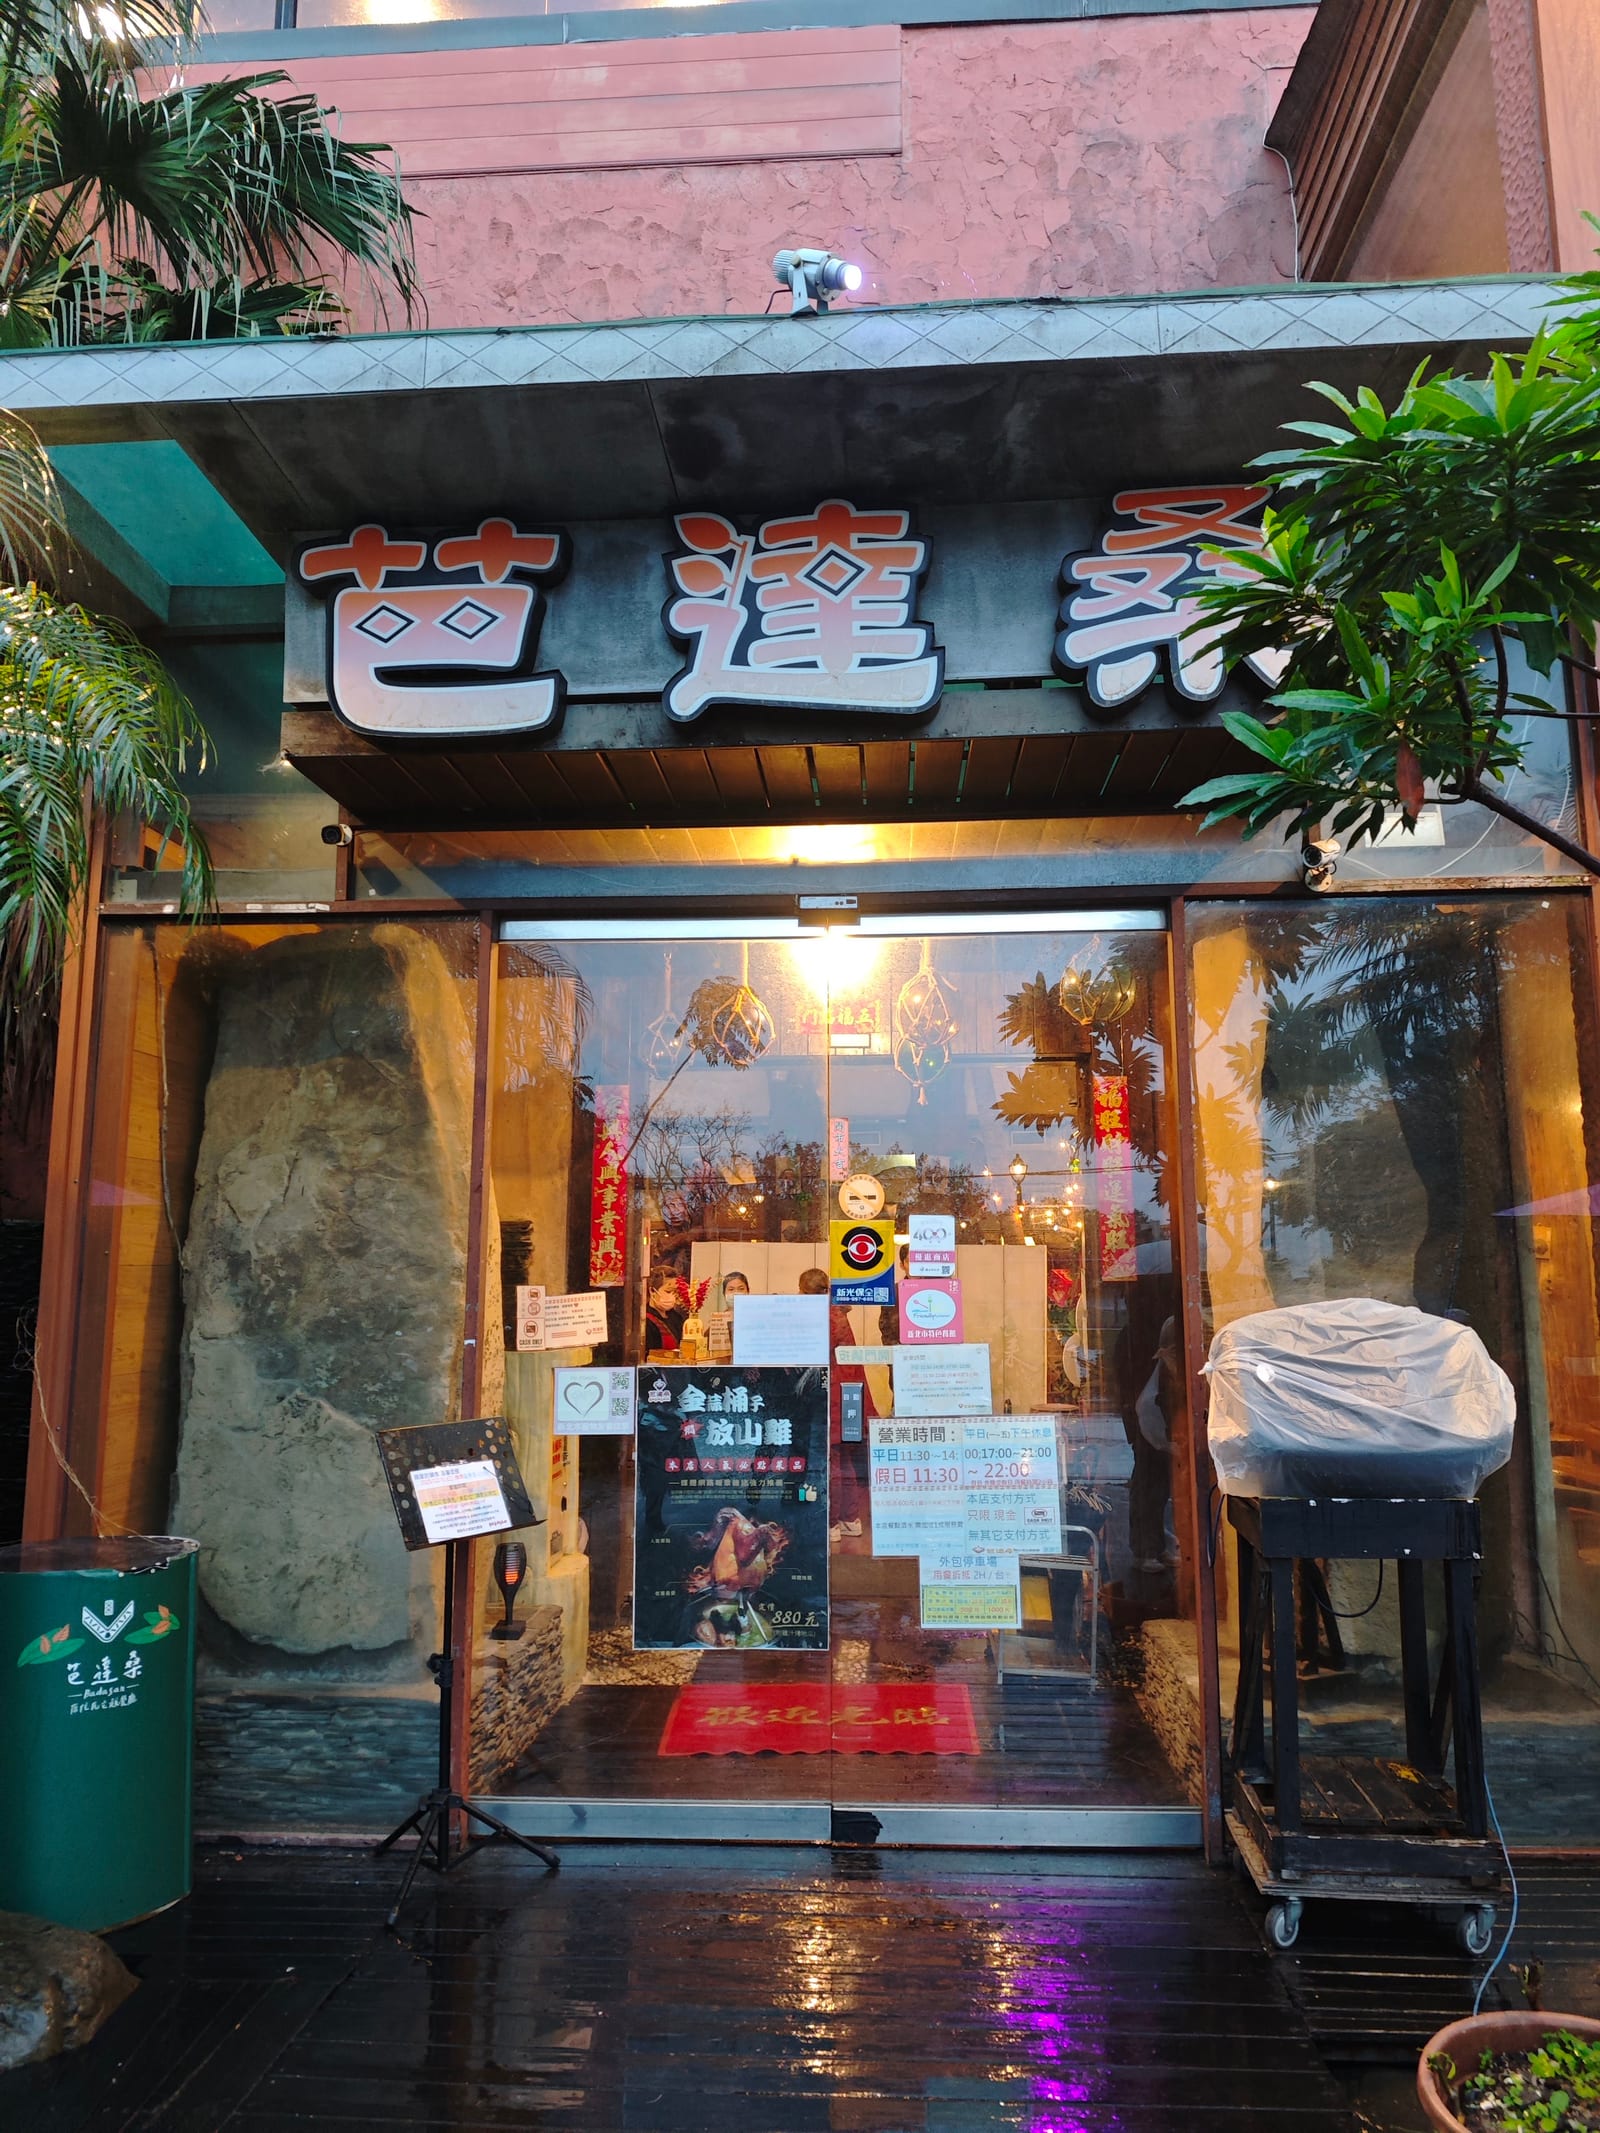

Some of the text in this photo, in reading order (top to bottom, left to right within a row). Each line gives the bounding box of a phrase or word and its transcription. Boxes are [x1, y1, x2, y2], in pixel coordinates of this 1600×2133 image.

[297, 484, 1288, 736] 芭達桑
[836, 1287, 873, 1296] 新光保全
[706, 1418, 793, 1446] 放山雞
[879, 1427, 956, 1444] 營業時間：
[875, 1468, 907, 1485] 假日
[913, 1468, 959, 1484] 11:30
[984, 1463, 1030, 1478] 22:00
[967, 1493, 1036, 1504] 本店支付方式
[968, 1509, 1017, 1521] 只限 現金
[968, 1529, 1050, 1541] 無其它支付方式
[940, 1556, 997, 1567] 外包停車場
[772, 1611, 819, 1627] 880 元
[67, 1650, 143, 1686] 芭達桑
[83, 1686, 125, 1699] Badasan
[697, 1706, 950, 1726] 歡迎光臨
